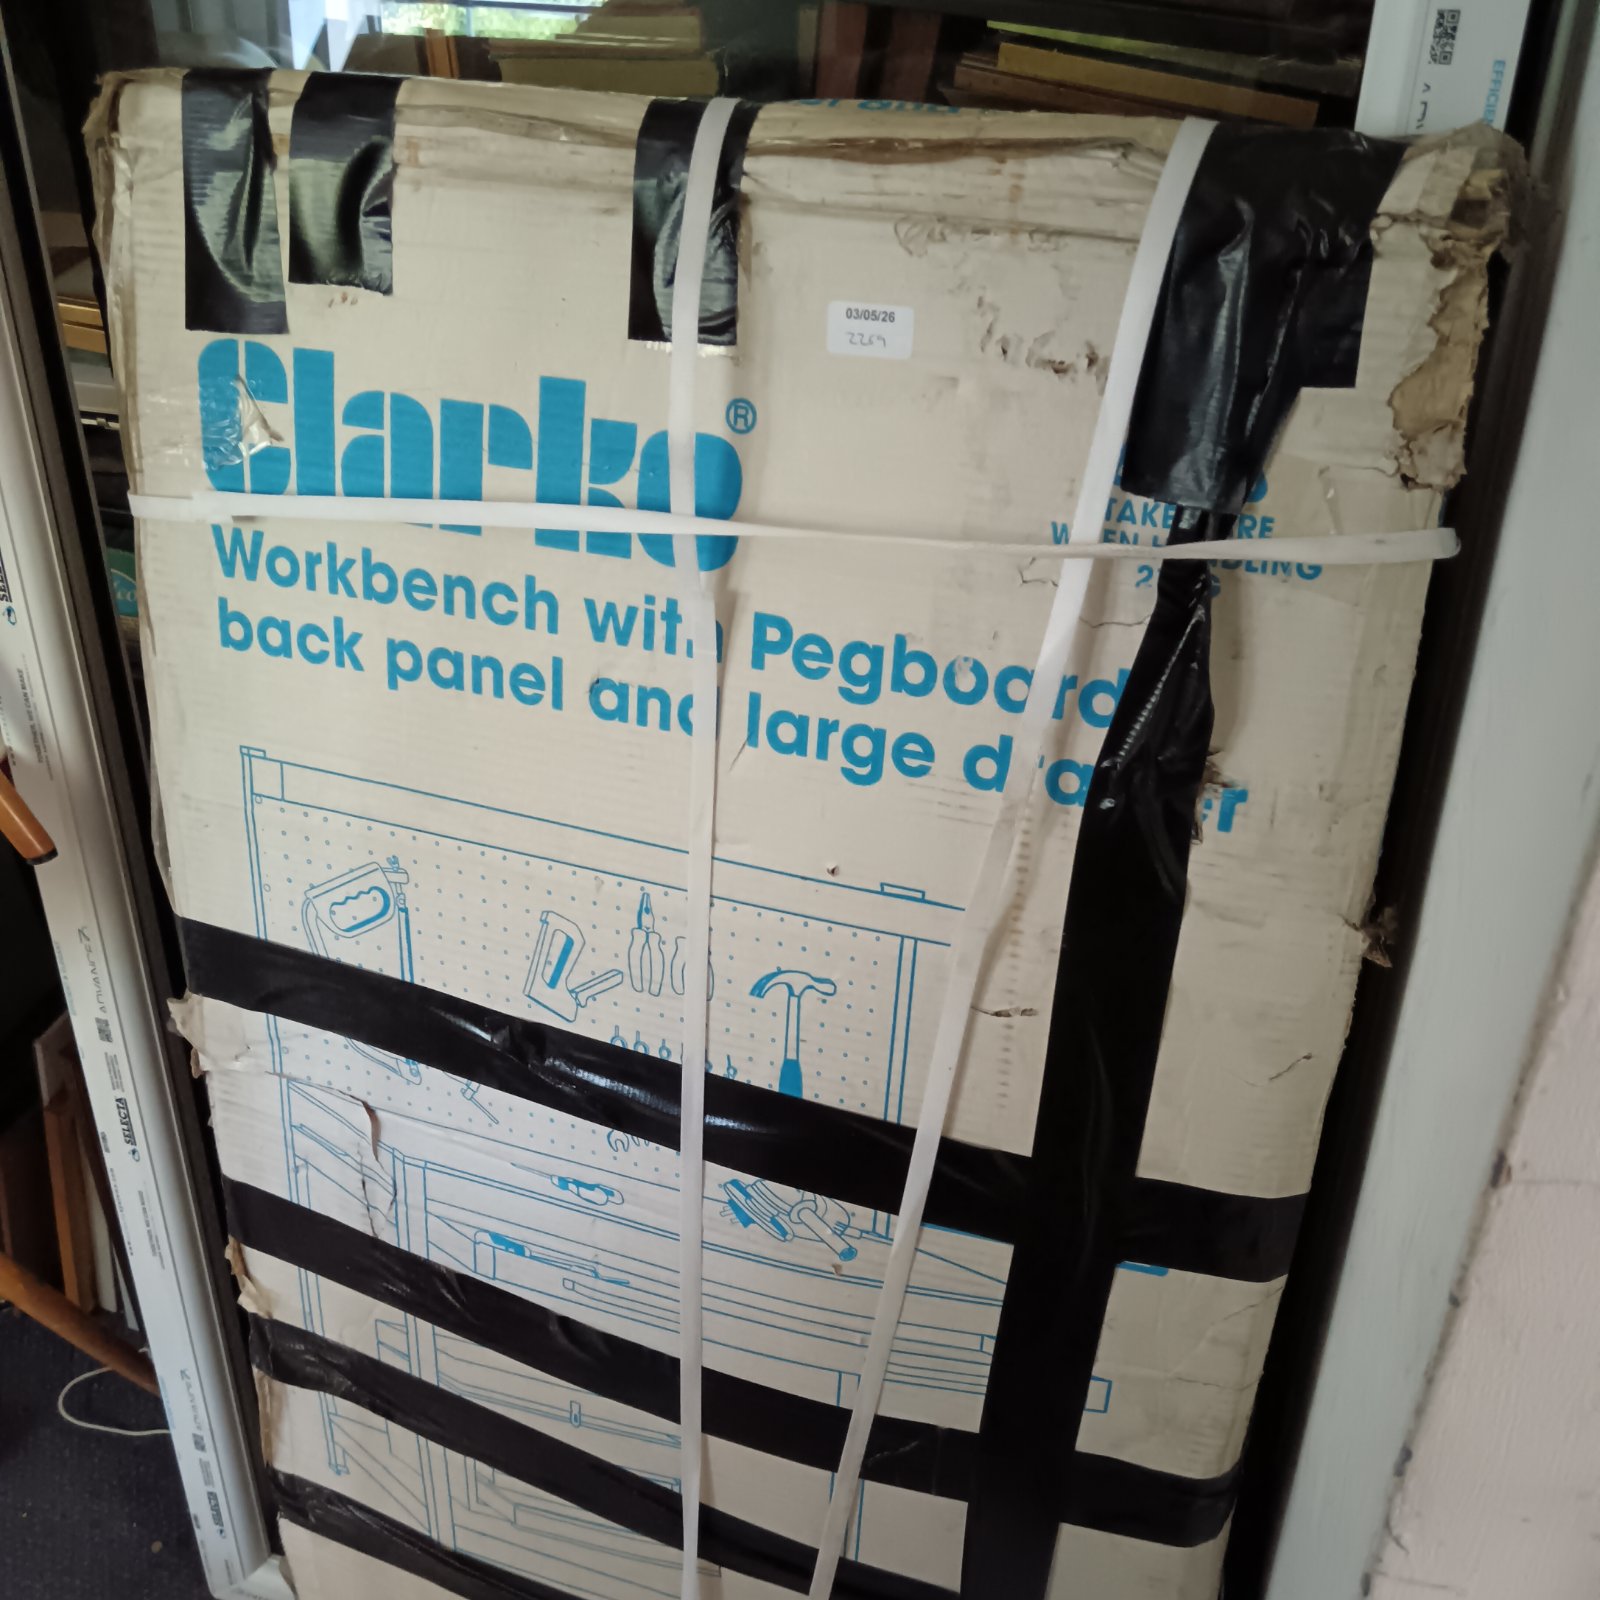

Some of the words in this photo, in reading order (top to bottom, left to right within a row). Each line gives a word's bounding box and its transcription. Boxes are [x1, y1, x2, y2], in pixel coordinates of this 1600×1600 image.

[845, 307, 896, 323] 03/05/26
[212, 524, 559, 635] Workbench
[751, 612, 1132, 729] Pegboard
[218, 597, 363, 672] back
[388, 639, 563, 710] panel
[746, 692, 935, 787] large
[114, 1097, 134, 1145] SELECTA
